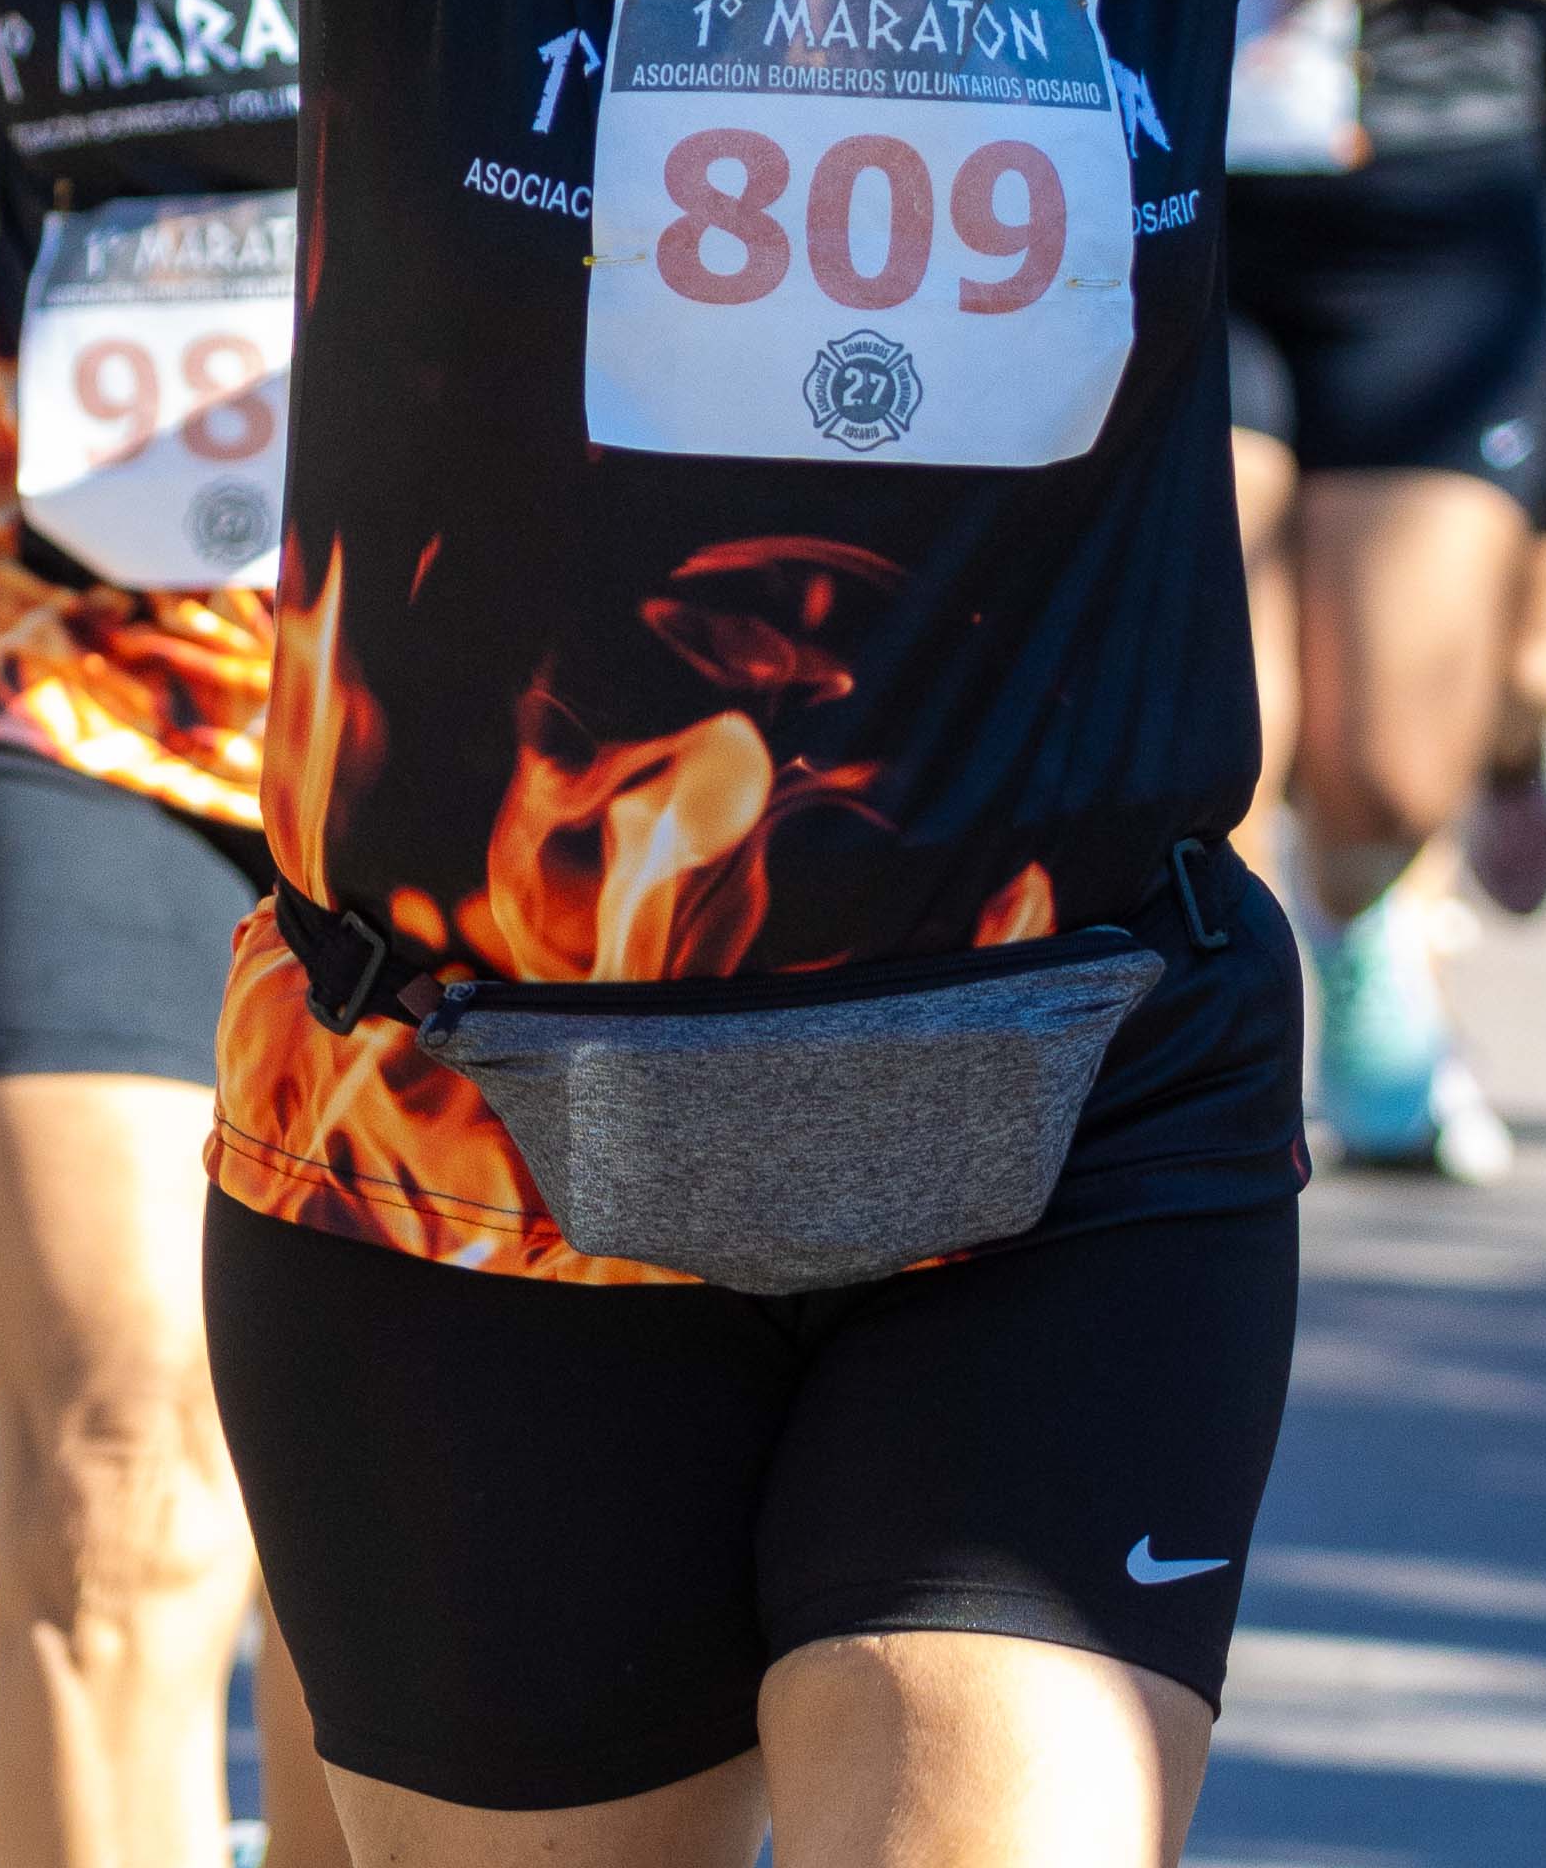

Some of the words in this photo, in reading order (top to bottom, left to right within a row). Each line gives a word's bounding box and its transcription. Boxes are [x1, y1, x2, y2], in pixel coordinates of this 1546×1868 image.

[631, 58, 761, 88] ASOCIACIÓN
[768, 64, 887, 92] BOMBEROS
[892, 69, 1022, 100] VOLUNTARIOS
[1026, 81, 1101, 106] ROSARIO
[656, 128, 1067, 314] 809
[73, 332, 275, 463] 98
[842, 366, 888, 407] 27
